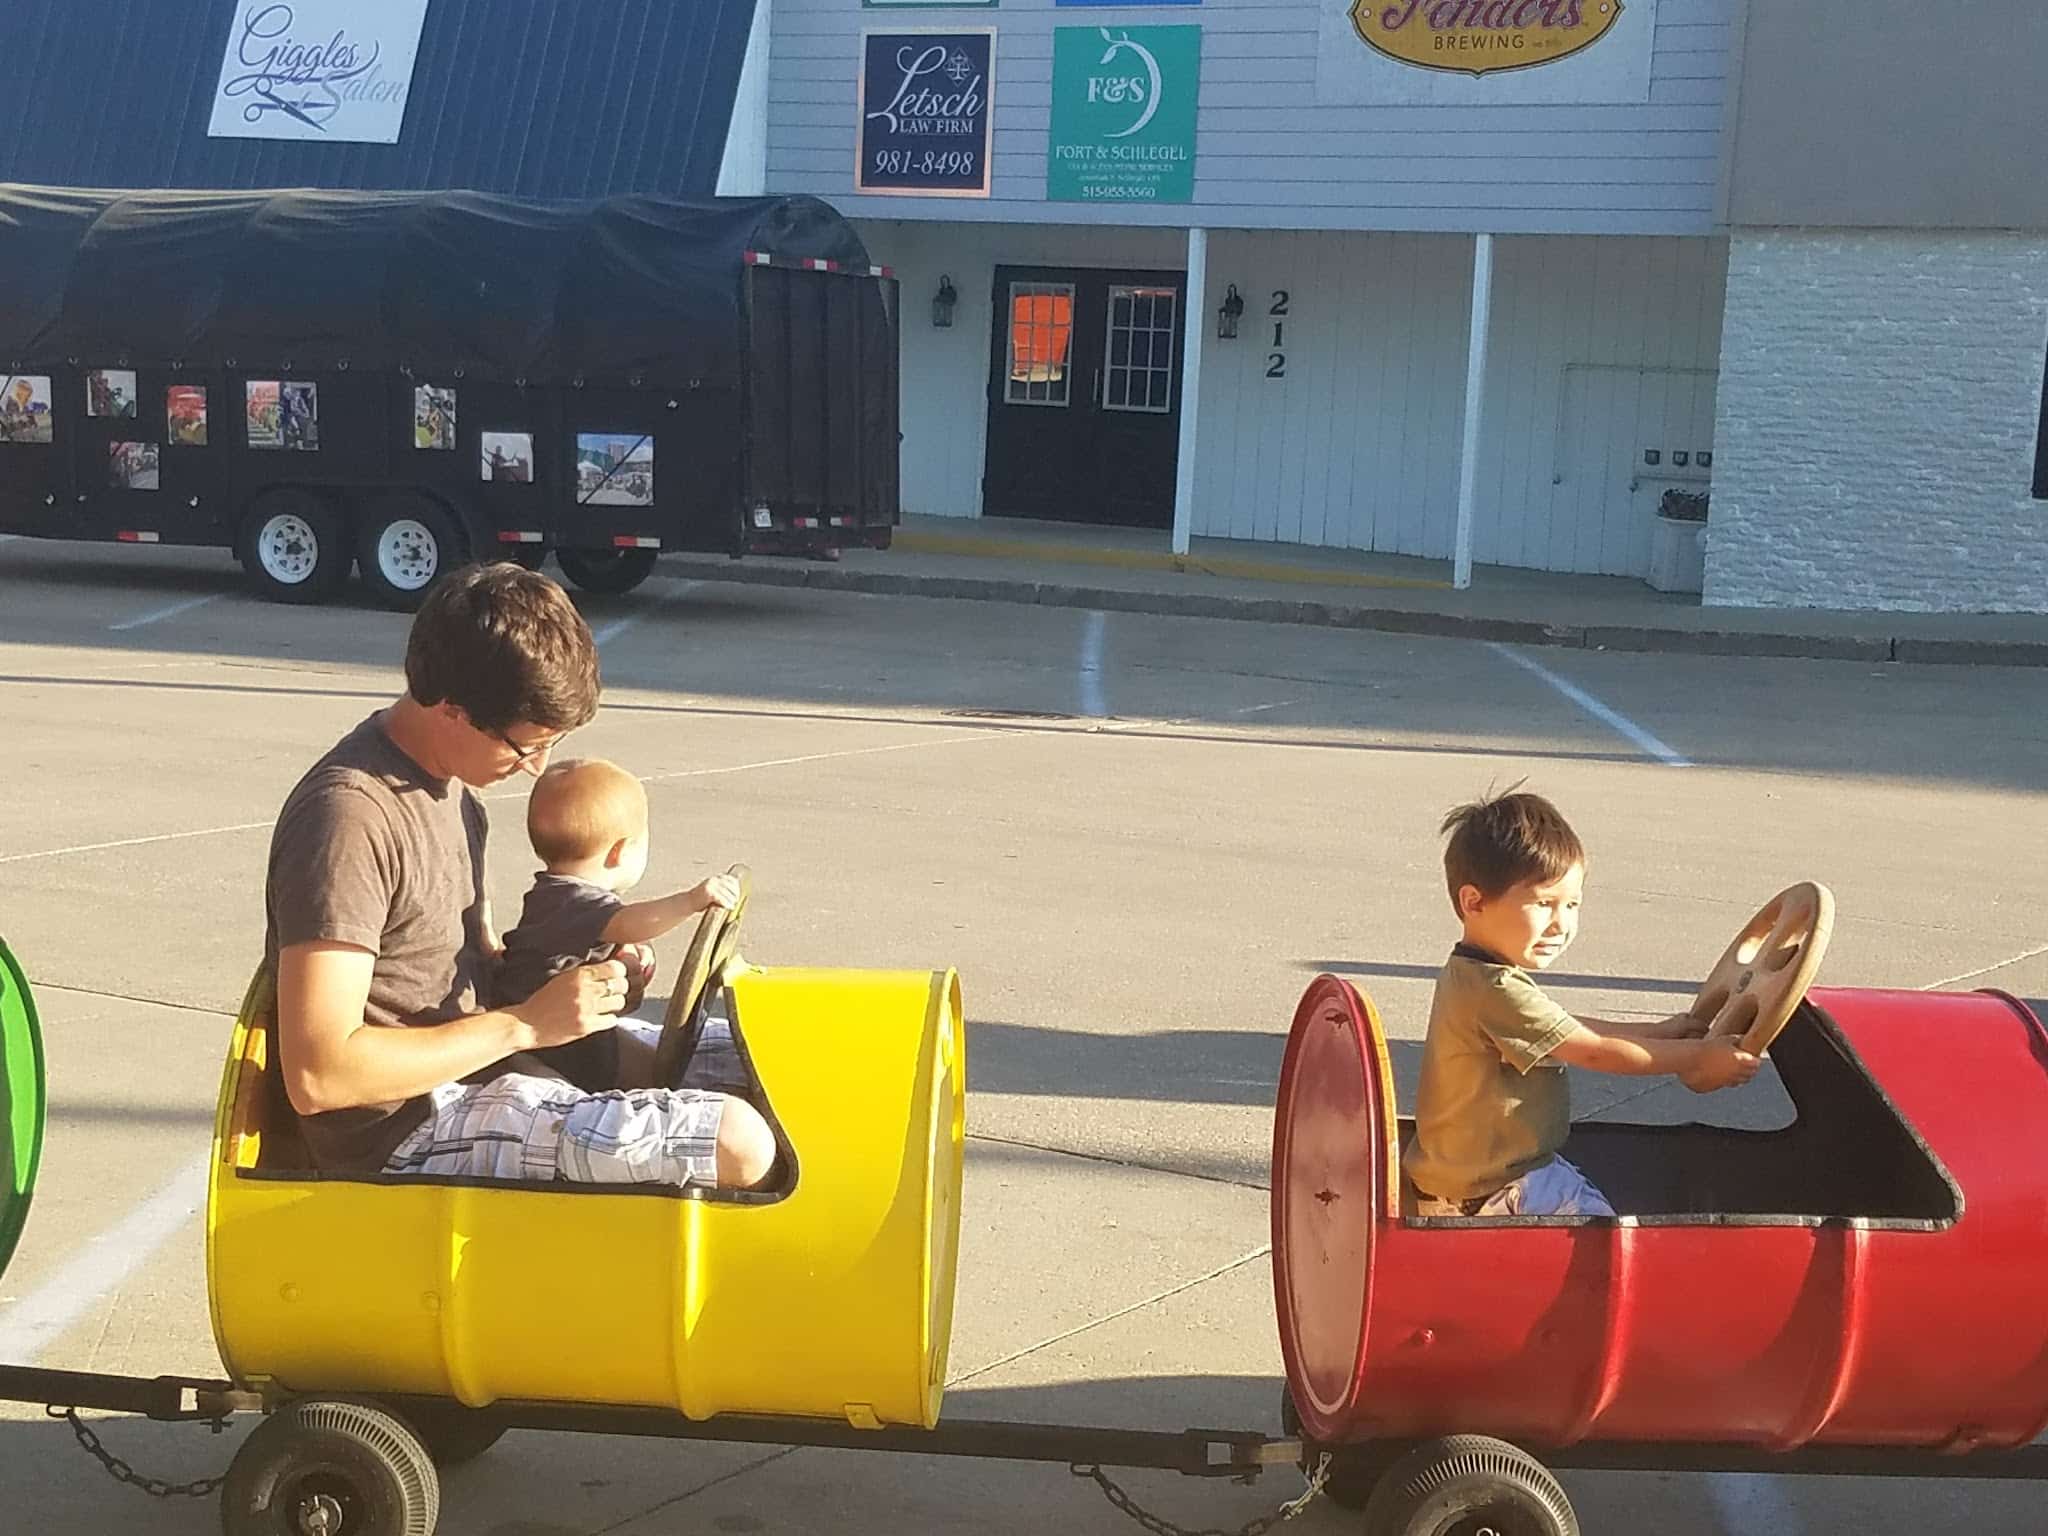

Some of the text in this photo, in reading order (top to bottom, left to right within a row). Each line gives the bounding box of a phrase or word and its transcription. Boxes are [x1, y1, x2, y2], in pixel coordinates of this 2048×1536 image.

[233, 5, 371, 92] Giggles
[1434, 34, 1525, 49] BREWING
[318, 63, 408, 113] Salon
[867, 46, 985, 133] Letsch
[1087, 77, 1146, 103] F&S
[900, 119, 974, 134] LAW FIRM
[873, 150, 975, 175] 981-8498
[1055, 145, 1187, 161] FORT & SCHLEGEL
